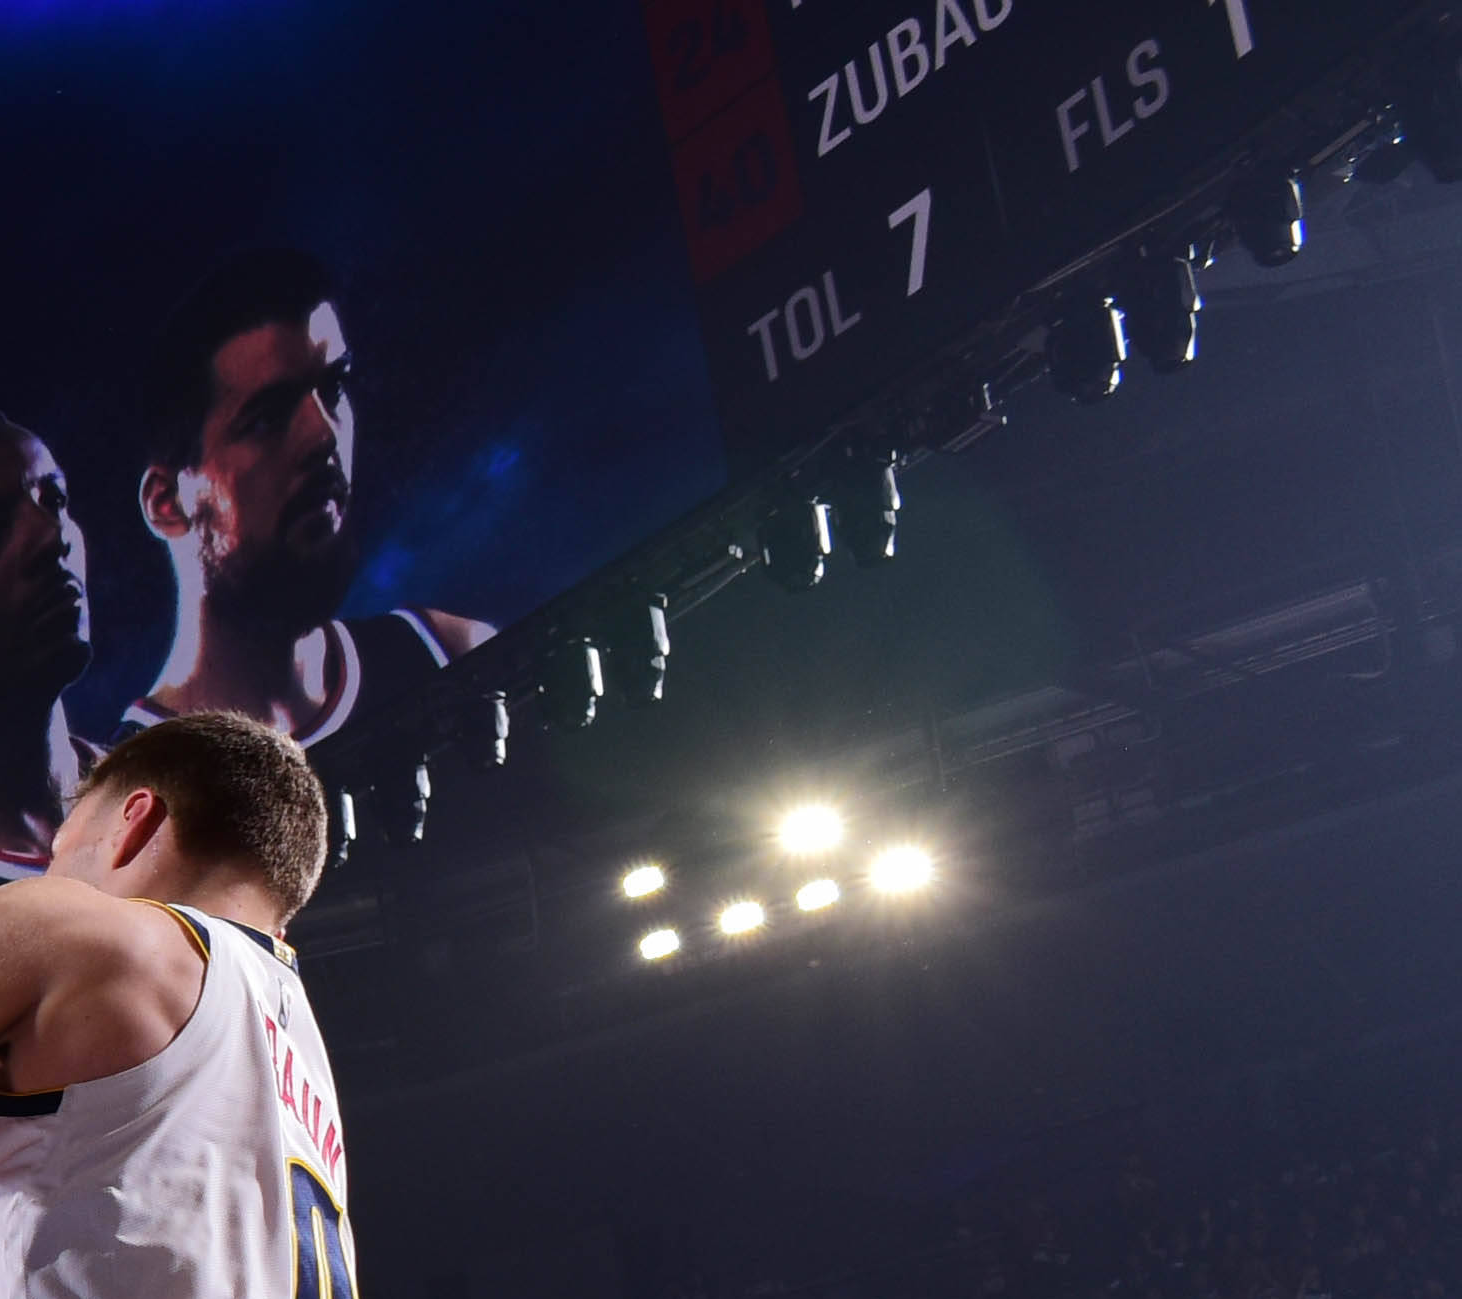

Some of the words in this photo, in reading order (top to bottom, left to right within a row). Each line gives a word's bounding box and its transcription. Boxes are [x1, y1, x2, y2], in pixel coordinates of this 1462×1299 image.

[1055, 38, 1171, 174] FLS
[747, 268, 862, 384] TOL
[888, 187, 933, 298] 7
